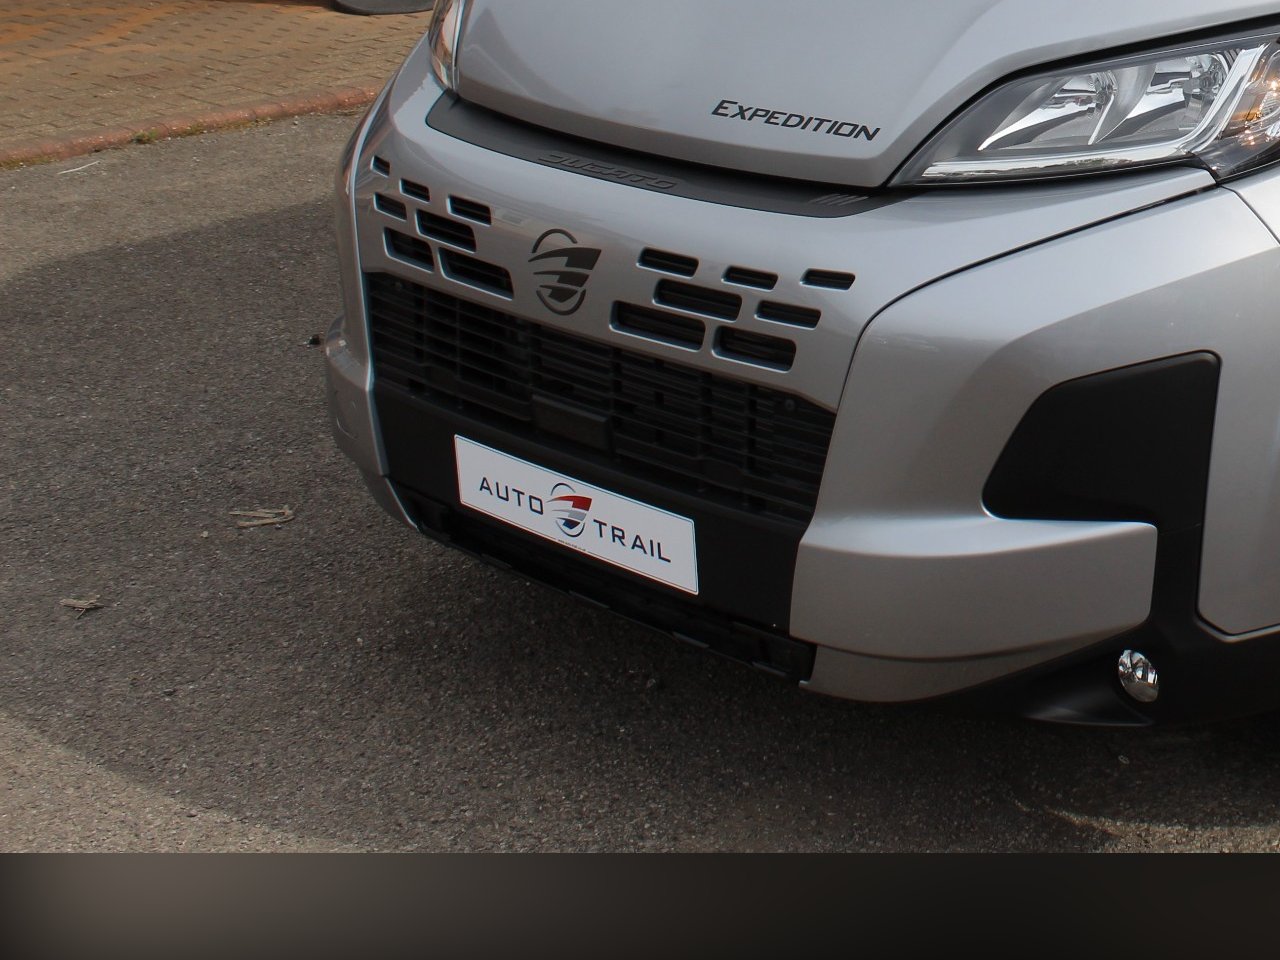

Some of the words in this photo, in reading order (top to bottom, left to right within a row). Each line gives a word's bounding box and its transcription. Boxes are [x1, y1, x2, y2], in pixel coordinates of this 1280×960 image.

[711, 99, 881, 141] EXPEDITION
[479, 476, 544, 516] AUTO
[593, 517, 672, 563] TRAIL
